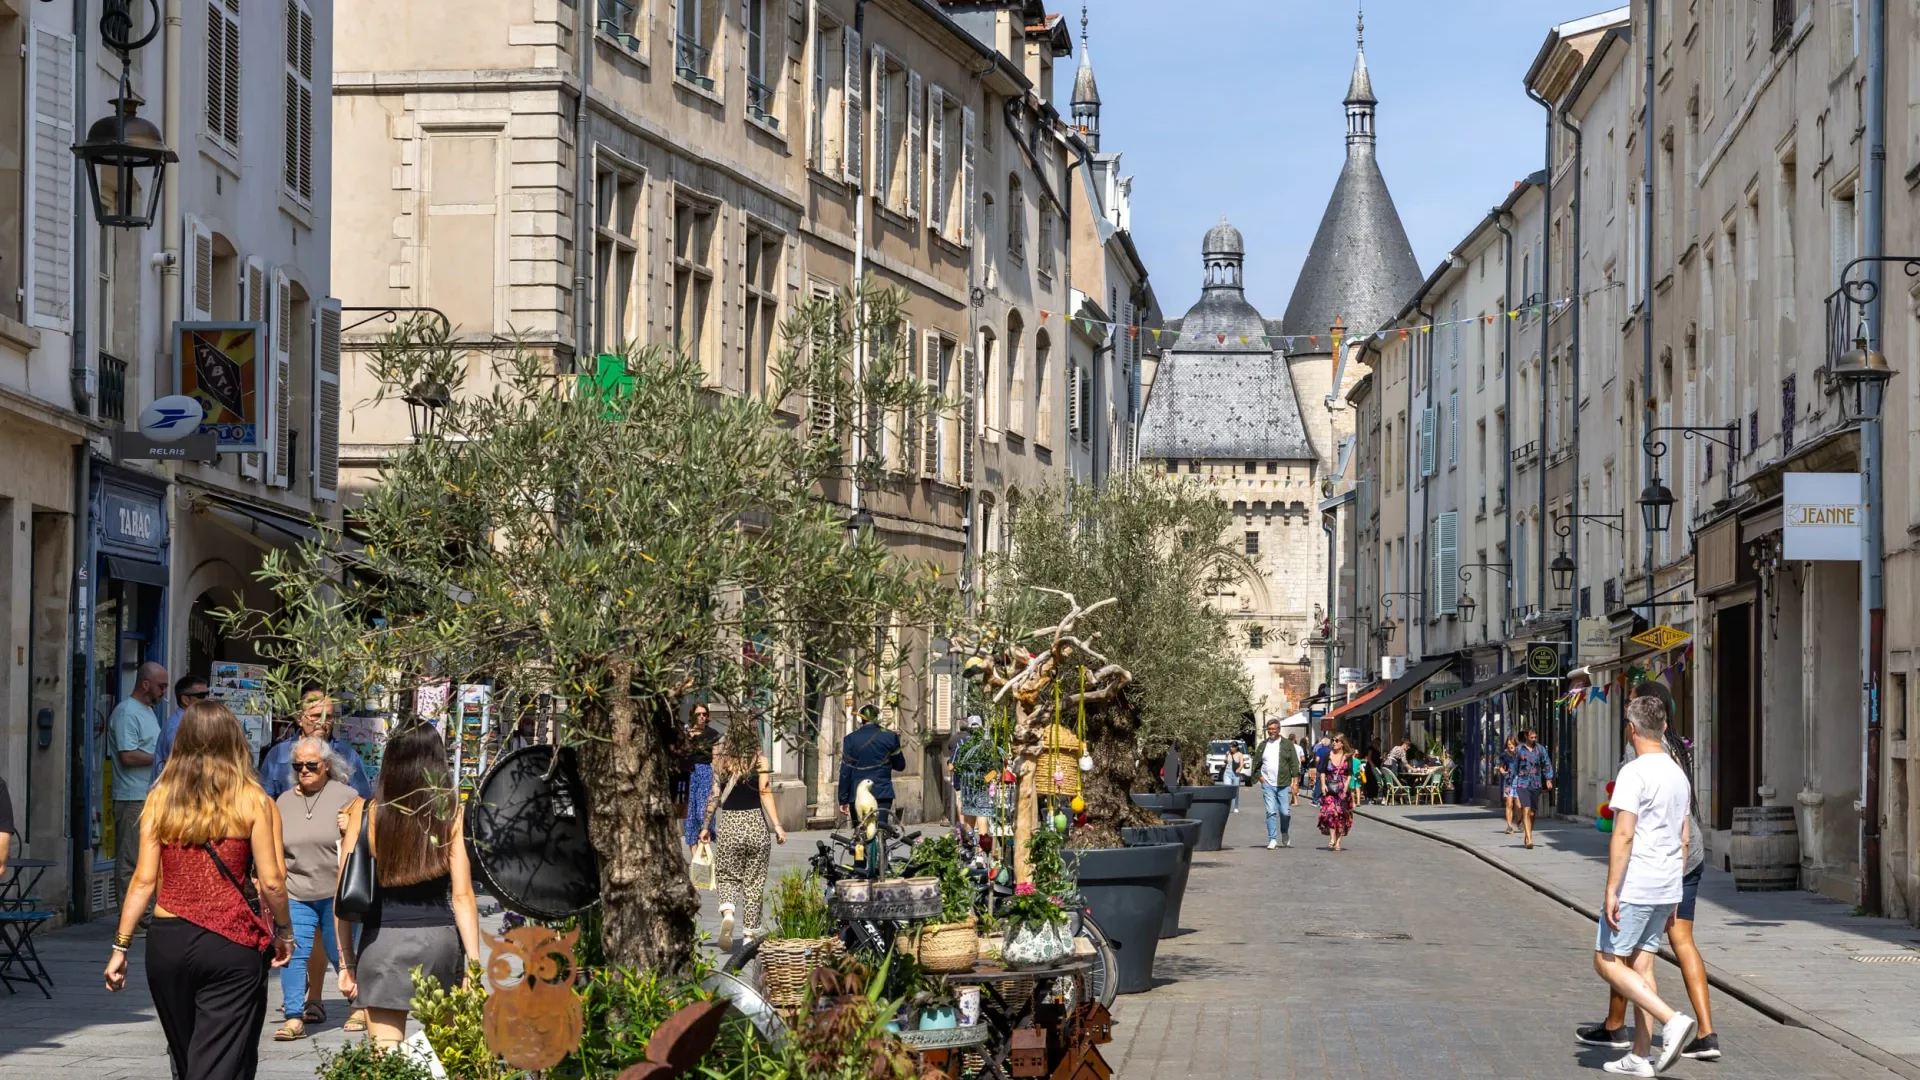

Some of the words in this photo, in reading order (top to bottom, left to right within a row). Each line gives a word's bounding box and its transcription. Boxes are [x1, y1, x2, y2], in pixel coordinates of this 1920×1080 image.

[200, 348, 232, 395] TABAC
[149, 447, 186, 456] RELAIS
[119, 507, 151, 540] TABAC
[1799, 507, 1855, 524] JEANNE
